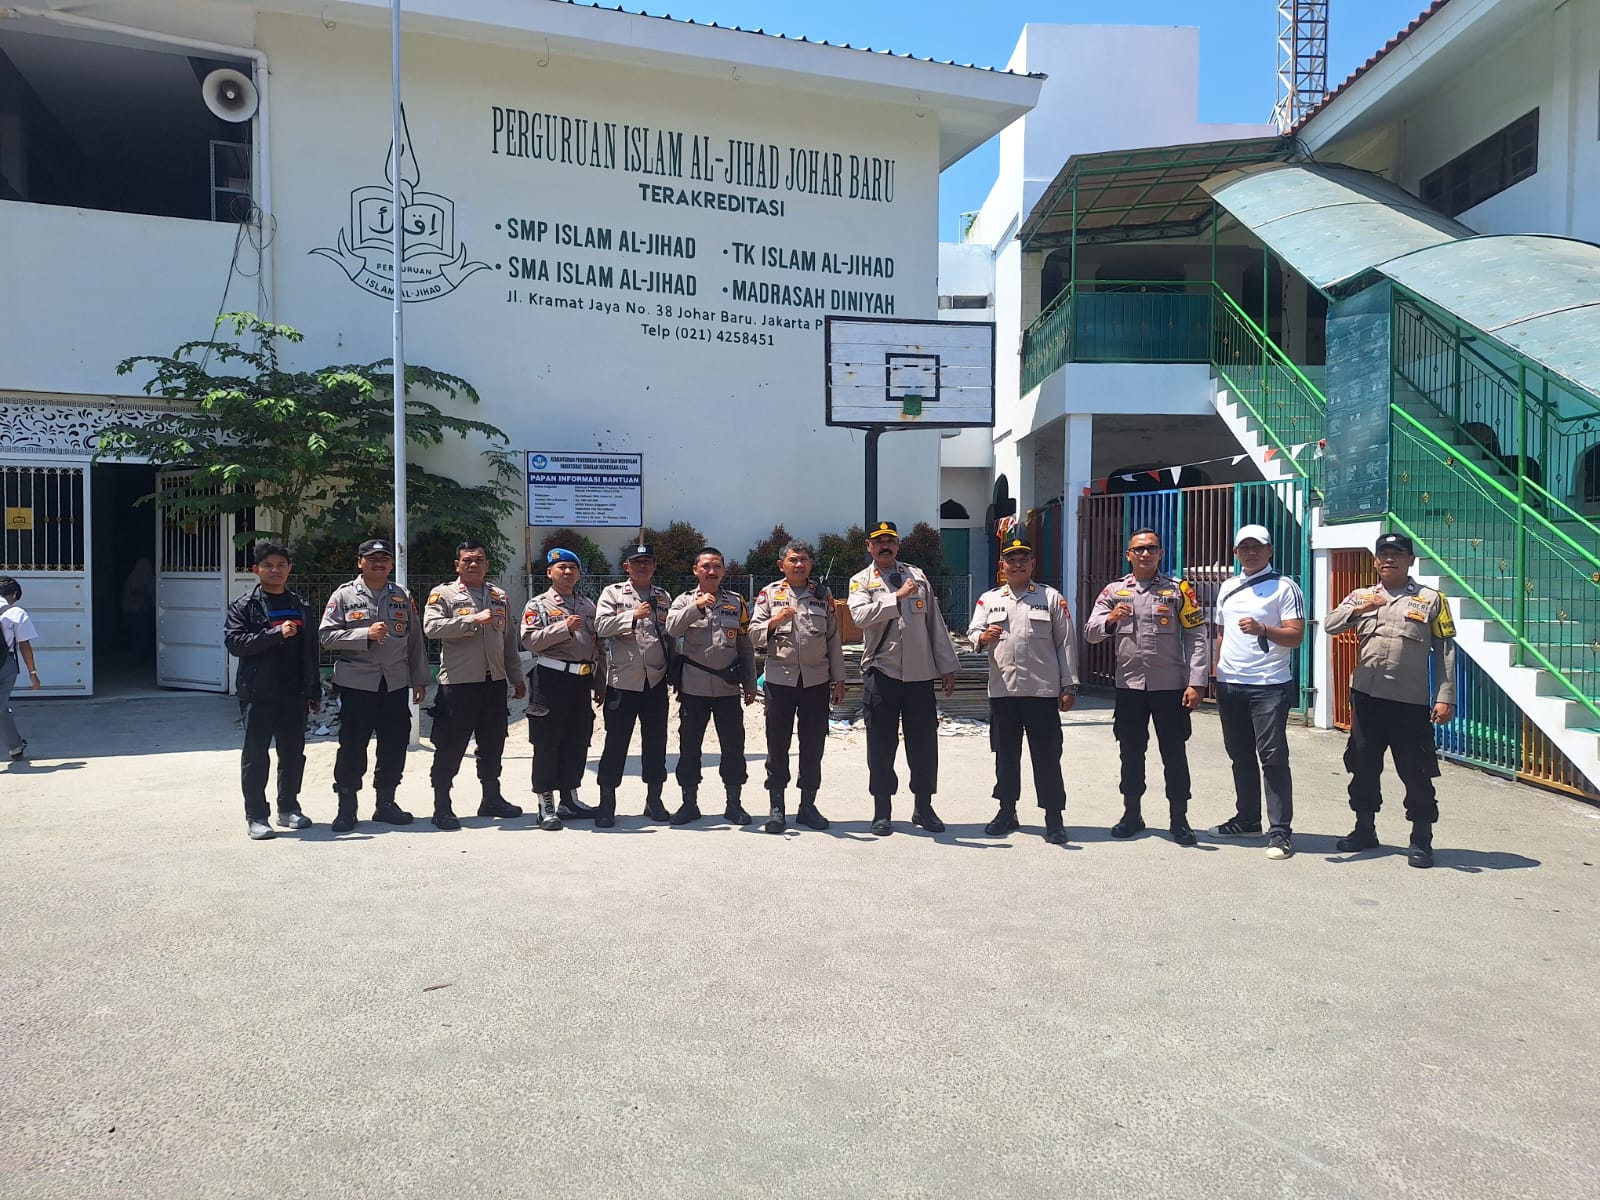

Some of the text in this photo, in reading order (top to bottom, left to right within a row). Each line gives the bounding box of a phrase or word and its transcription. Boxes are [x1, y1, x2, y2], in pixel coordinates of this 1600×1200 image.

[491, 105, 896, 203] PERGURUAN ISLAM AL-JIHAD JOHAR BARU
[638, 182, 785, 218] TERAKREDITASI
[507, 217, 696, 260] SMP ISLAM AL-JIHAD
[376, 263, 432, 275] PERURUAN
[508, 255, 697, 297] SMA ISLAM AL-JIHAD
[731, 241, 895, 279] TK ISLAM AL-JIHAD
[528, 292, 584, 310] Kramat
[588, 298, 620, 315] Jaya
[625, 301, 651, 317] No.
[656, 303, 673, 318] 38
[676, 306, 717, 322] Johar
[761, 313, 811, 331] Jakarta
[732, 279, 895, 314] MADRASAH DINIYAH
[641, 323, 775, 347] Telp (021) 4258451
[530, 474, 639, 484] PAPAN INFORMASI BANTUAN
